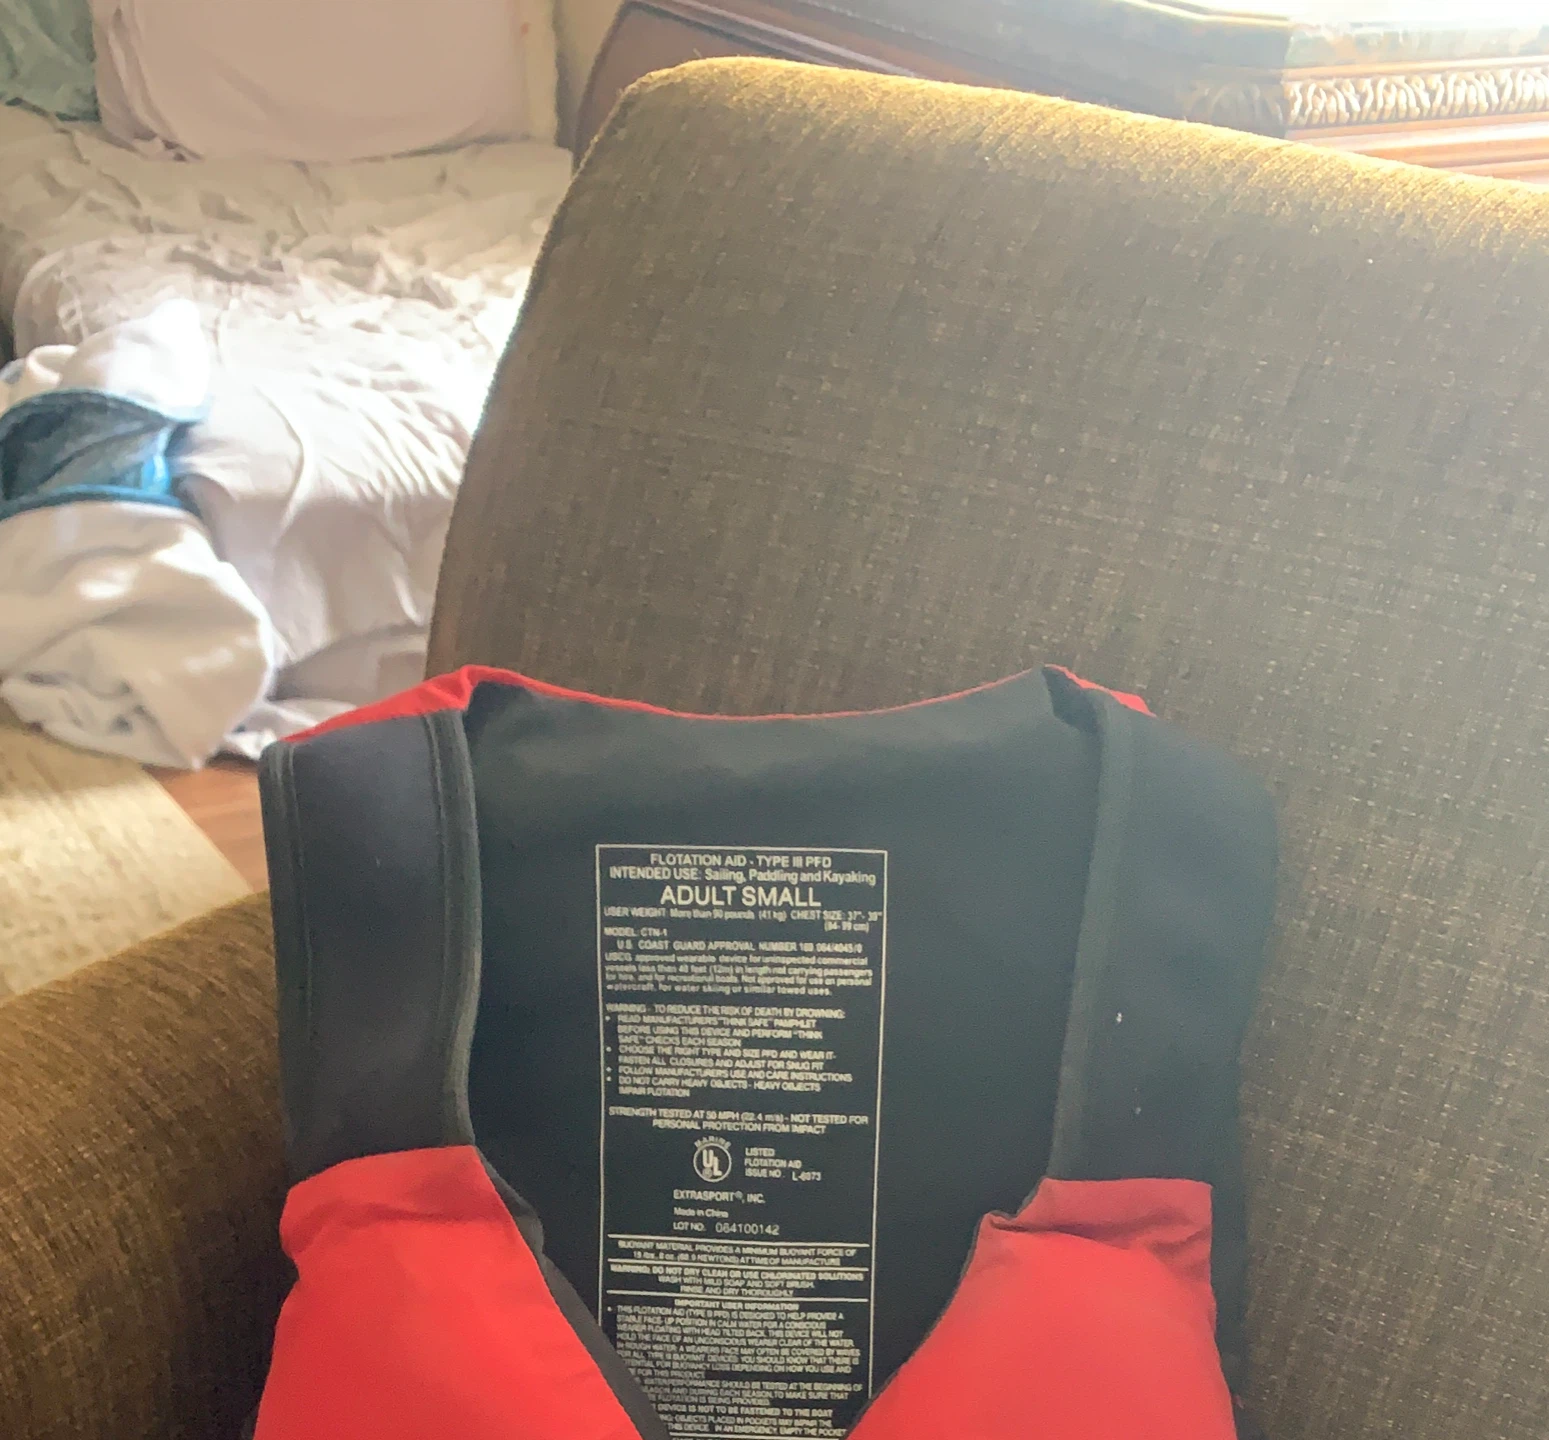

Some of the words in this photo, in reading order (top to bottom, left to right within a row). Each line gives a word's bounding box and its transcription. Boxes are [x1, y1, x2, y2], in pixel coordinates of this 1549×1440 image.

[651, 854, 722, 866] FLOTATION
[725, 855, 747, 867] AID
[756, 855, 790, 868] TYPE
[806, 856, 832, 868] PFD
[610, 866, 672, 880] INTENDED
[748, 868, 799, 885] Paddling
[800, 870, 822, 882] and
[823, 870, 876, 886] Kayaking
[660, 885, 738, 906] ADULT
[742, 886, 822, 907] SMALL
[790, 910, 822, 920] CHEST
[638, 940, 668, 950] COAST
[673, 940, 706, 951] GUARD
[654, 1004, 666, 1014] TO
[667, 1005, 702, 1014] REDUCE
[702, 1005, 720, 1015] THE
[741, 1006, 753, 1016] OF
[754, 1007, 782, 1016] DEATH
[784, 1007, 795, 1017] BY
[732, 1028, 750, 1037] AND
[658, 1046, 673, 1055] THE
[700, 1048, 722, 1056] TYPE
[723, 1048, 742, 1057] AND
[780, 1050, 798, 1059] AND
[799, 1050, 825, 1060] WEAR
[652, 1056, 666, 1066] ALL
[715, 1058, 734, 1068] AND
[767, 1060, 785, 1070] FOR
[786, 1061, 810, 1070] SNUG
[618, 1066, 654, 1074] FOLLOW
[730, 1069, 747, 1078] USE
[748, 1070, 766, 1079] AND
[766, 1070, 790, 1080] CARE
[790, 1072, 854, 1082] INSTRUCTIONS
[618, 1076, 632, 1085] DO
[633, 1076, 650, 1086] NOT
[681, 1078, 708, 1088] HEAVY
[710, 1079, 748, 1090] OBJECTS
[754, 1081, 781, 1091] HEAVY
[782, 1082, 822, 1092] OBJECTS
[608, 1106, 657, 1116] STRENGTH
[658, 1108, 692, 1118] TESTED
[693, 1110, 705, 1119] AT
[718, 1111, 740, 1120] MPH
[790, 1114, 810, 1124] NOT
[812, 1114, 848, 1124] TESTED
[848, 1115, 869, 1125] FOR
[652, 1119, 700, 1130] PERSONAL
[702, 1120, 762, 1132] PROTECTION
[762, 1123, 790, 1133] FROM
[792, 1124, 826, 1134] IMPACT
[745, 1148, 776, 1157] LISTED
[744, 1158, 787, 1168] FLOTATION
[788, 1160, 802, 1169] AID
[745, 1168, 768, 1178] ISSUE
[747, 1193, 766, 1204] INC.
[674, 1207, 696, 1216] Made
[697, 1208, 705, 1217] in
[706, 1208, 729, 1218] China
[673, 1222, 689, 1231] LOT
